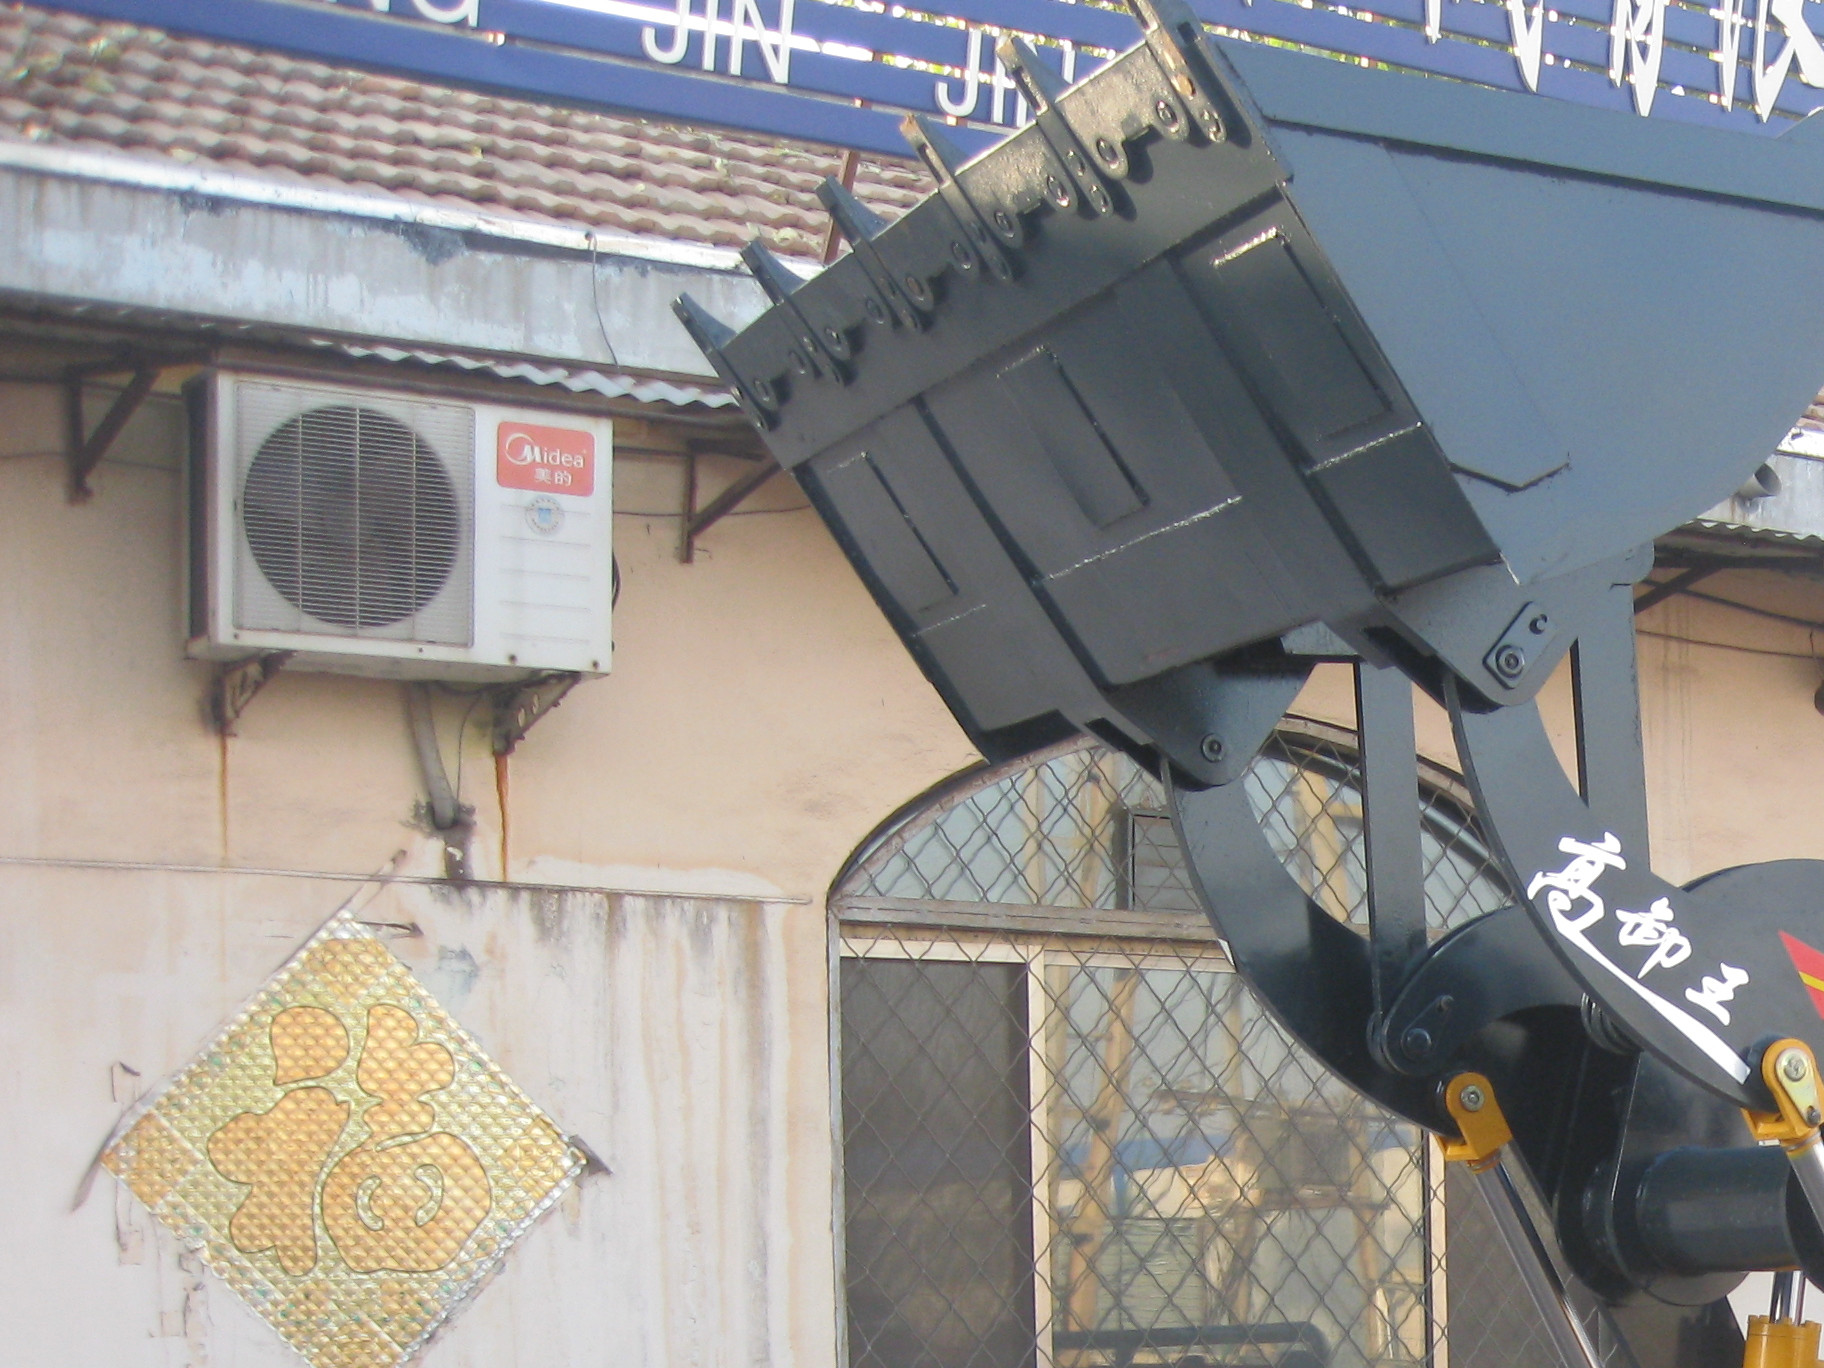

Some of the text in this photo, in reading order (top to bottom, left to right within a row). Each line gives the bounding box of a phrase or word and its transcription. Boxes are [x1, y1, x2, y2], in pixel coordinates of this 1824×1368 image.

[642, 0, 794, 85] JIN
[512, 440, 584, 468] Midea
[535, 467, 572, 487] 美的
